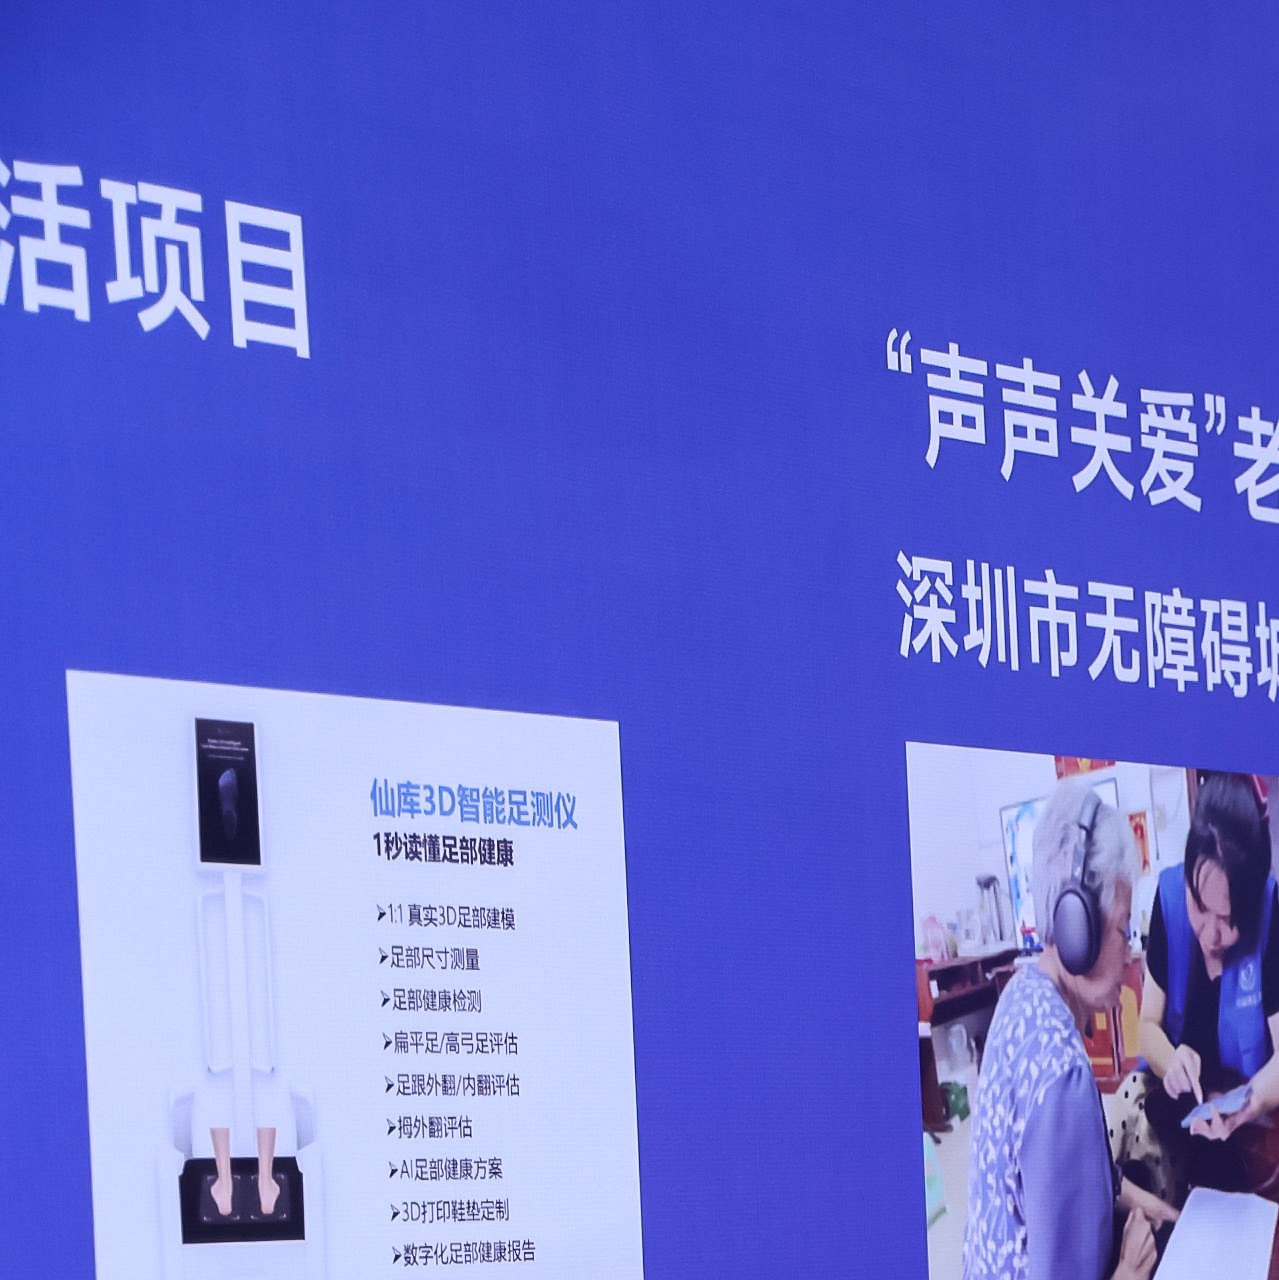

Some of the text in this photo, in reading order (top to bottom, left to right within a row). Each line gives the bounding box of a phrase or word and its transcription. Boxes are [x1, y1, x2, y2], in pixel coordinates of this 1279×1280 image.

[0, 158, 310, 359] 活项目
[370, 777, 579, 830] 仙库3D智能足测仪
[372, 830, 515, 868] 1秒读懂足部健康
[390, 945, 481, 971] 足部尺寸测量
[392, 988, 482, 1014] 足部健康检测
[394, 1030, 519, 1056] 扁平足/高弓足评估
[396, 1073, 520, 1098] 足跟外翻/内翻评估
[398, 1115, 473, 1140] 拇外翻评估
[400, 1157, 503, 1182] AI足部健康方案
[401, 1198, 510, 1223] 3D打印鞋垫定制
[403, 1239, 536, 1267] 数字化足部健康报告
